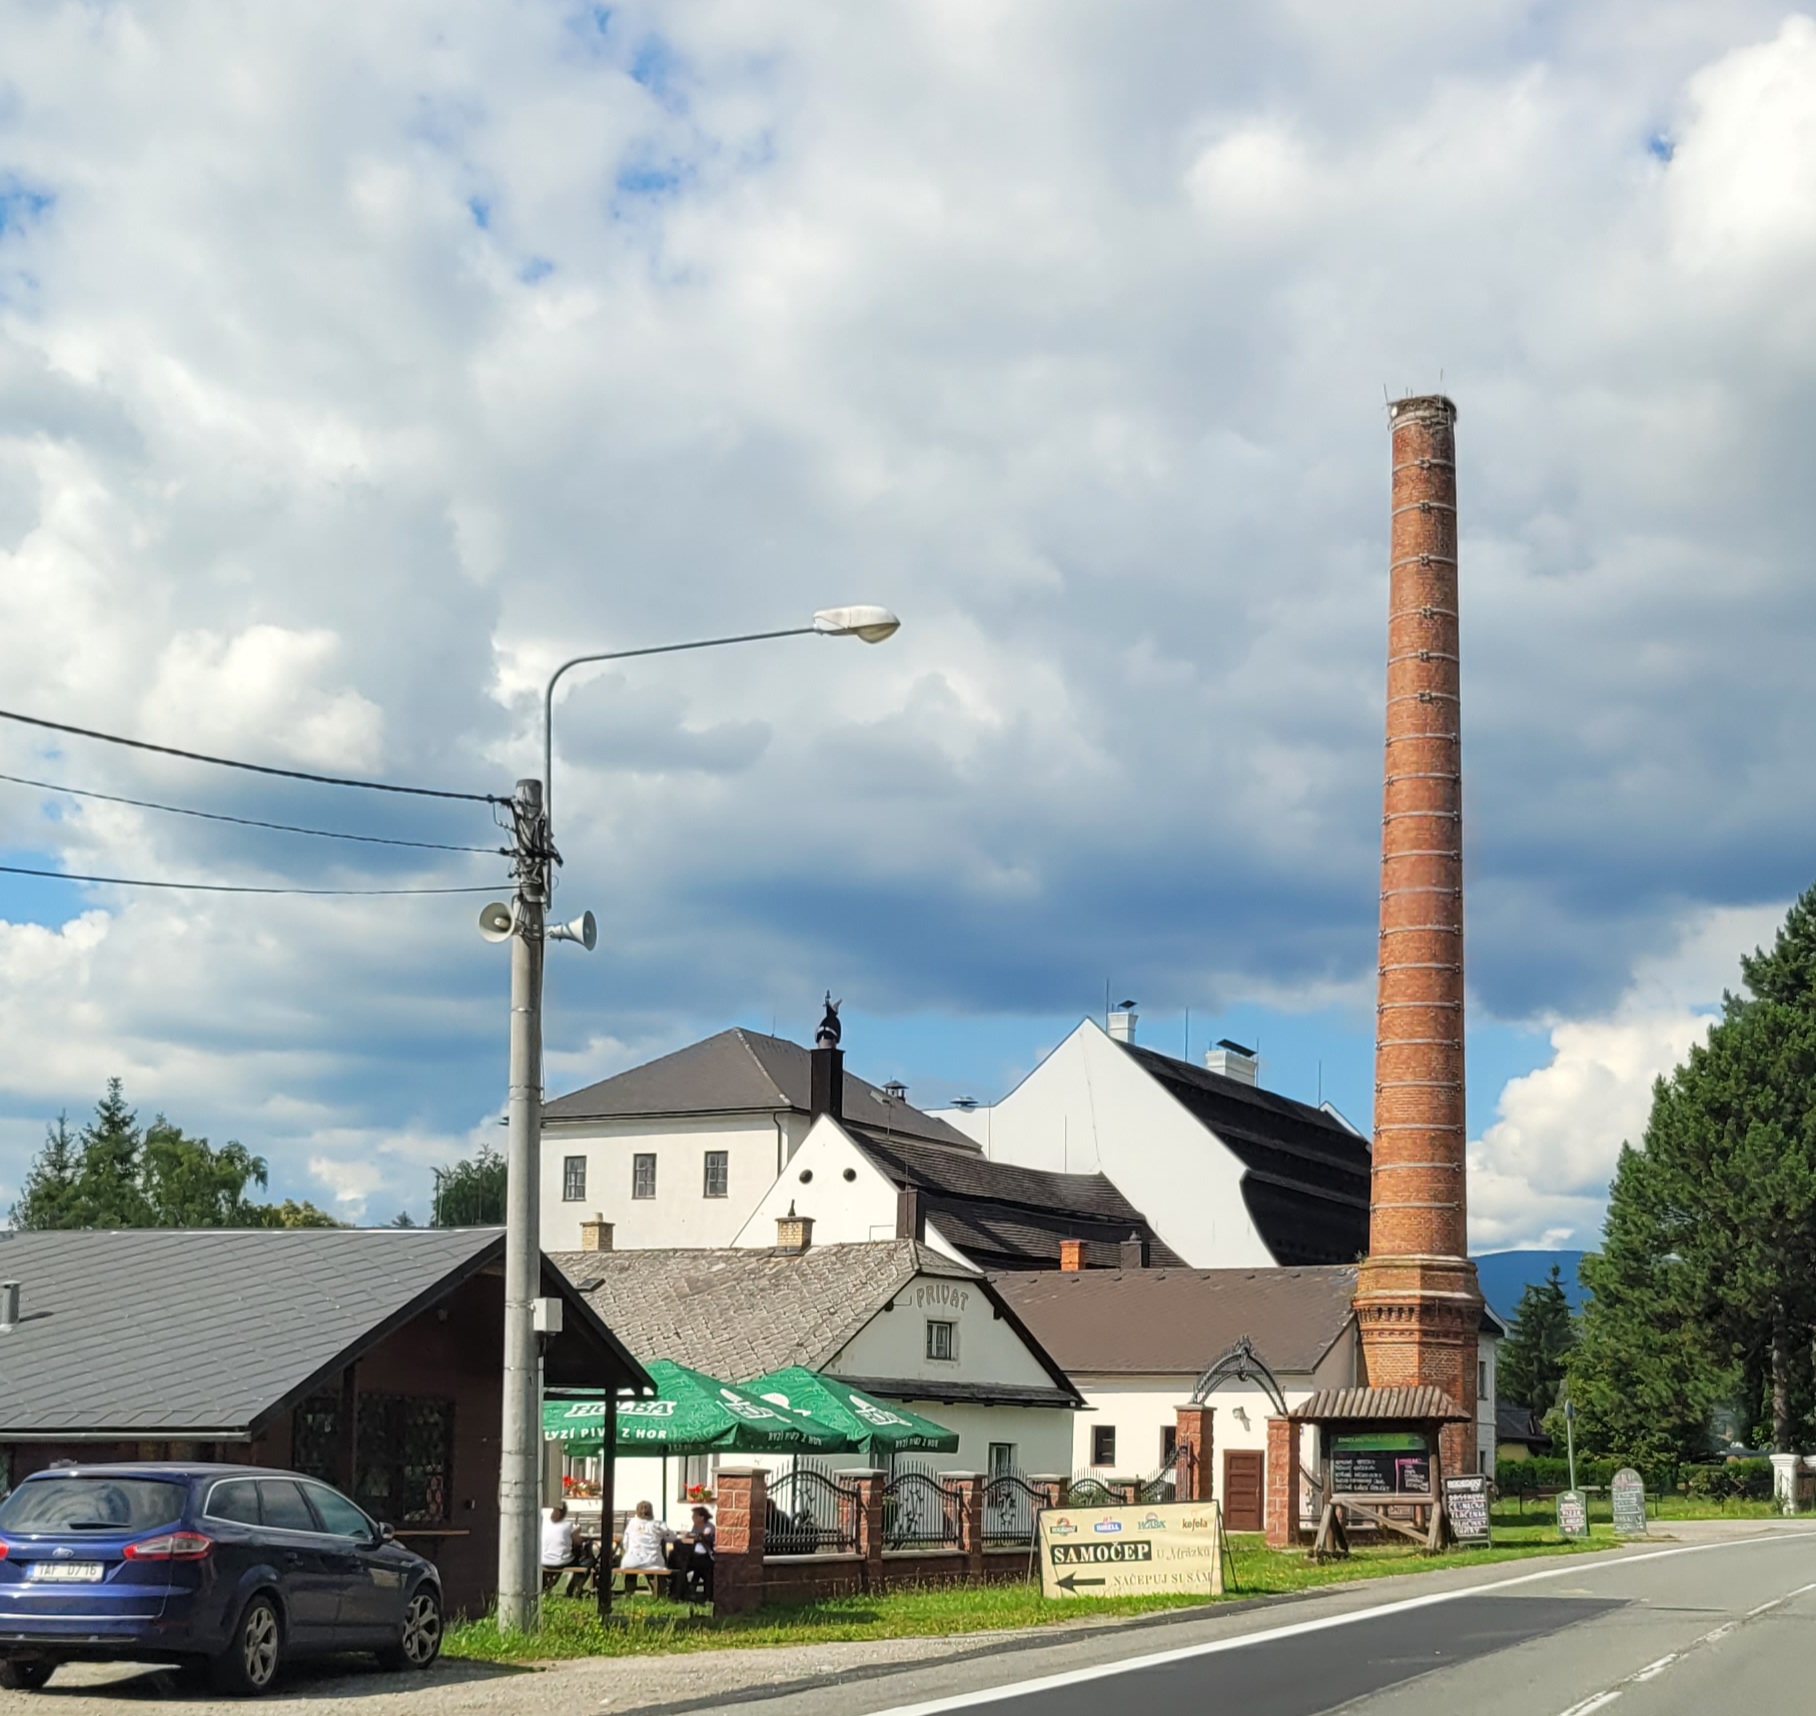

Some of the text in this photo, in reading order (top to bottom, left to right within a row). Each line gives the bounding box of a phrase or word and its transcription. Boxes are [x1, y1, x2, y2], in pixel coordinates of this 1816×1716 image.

[916, 1284, 969, 1311] PRIVAT
[580, 1427, 605, 1438] PIV
[622, 1428, 630, 1438] Z
[636, 1429, 667, 1439] HOR
[1182, 1517, 1208, 1532] kofola
[1054, 1541, 1150, 1563] SAMOČEP
[1157, 1549, 1164, 1559] U
[1171, 1573, 1183, 1583] SI
